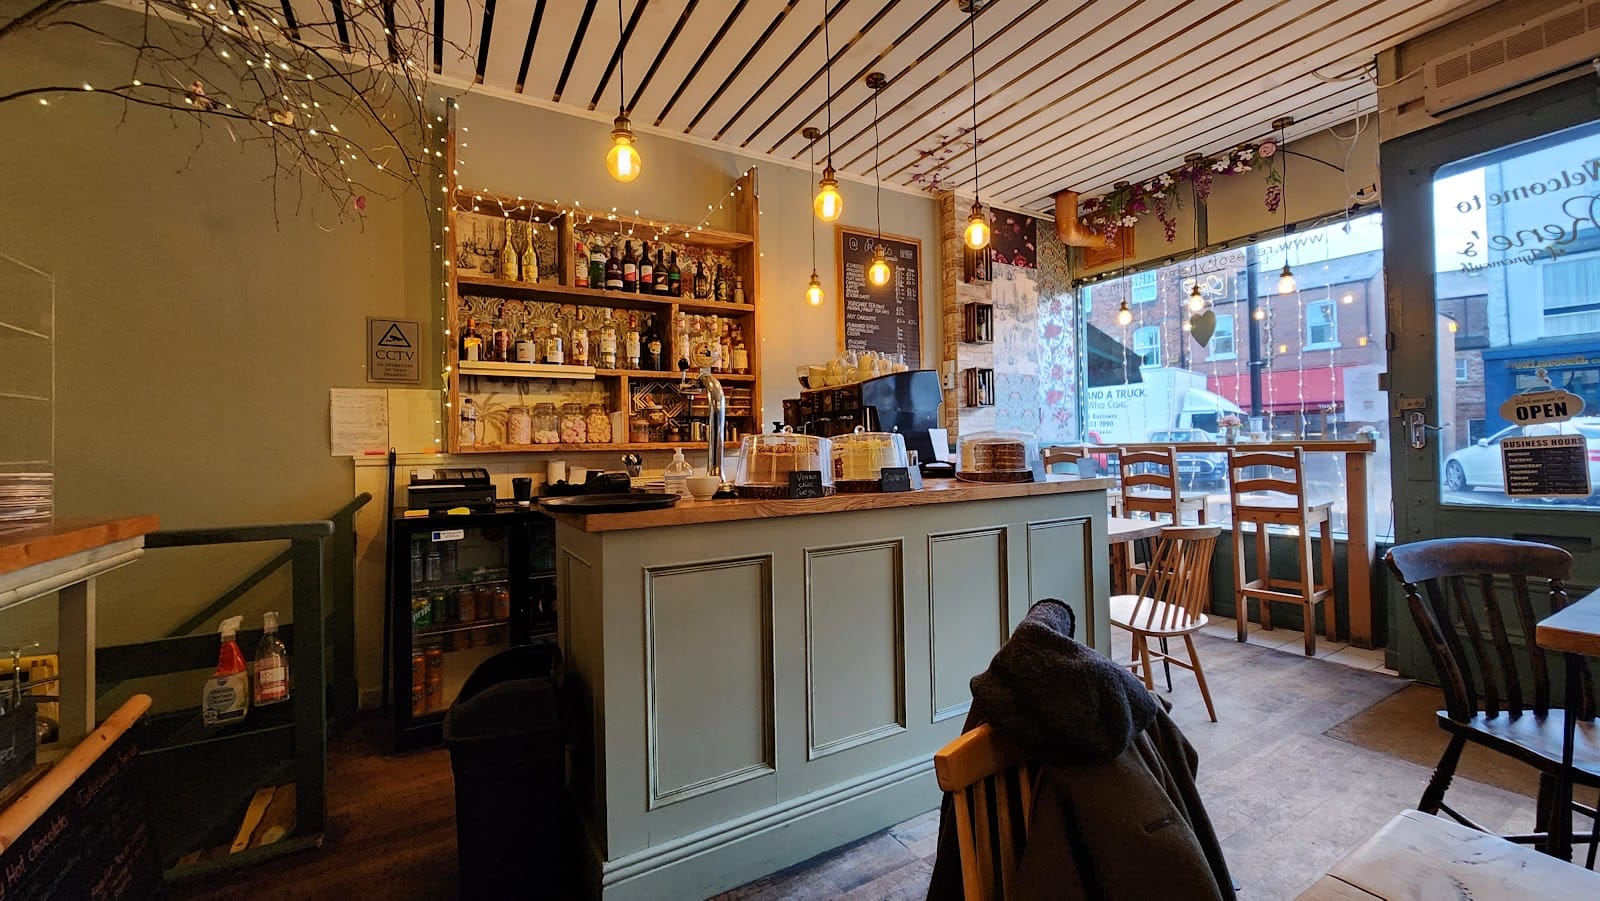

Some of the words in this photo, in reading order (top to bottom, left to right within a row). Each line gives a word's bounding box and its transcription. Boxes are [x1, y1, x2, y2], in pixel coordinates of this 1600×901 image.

[375, 349, 414, 361] CCTV
[1106, 390, 1113, 399] A
[1116, 387, 1145, 399] TRUCK
[1516, 401, 1568, 421] OPEN
[1503, 439, 1549, 449] BUSINESS
[1551, 437, 1585, 446] HOURS
